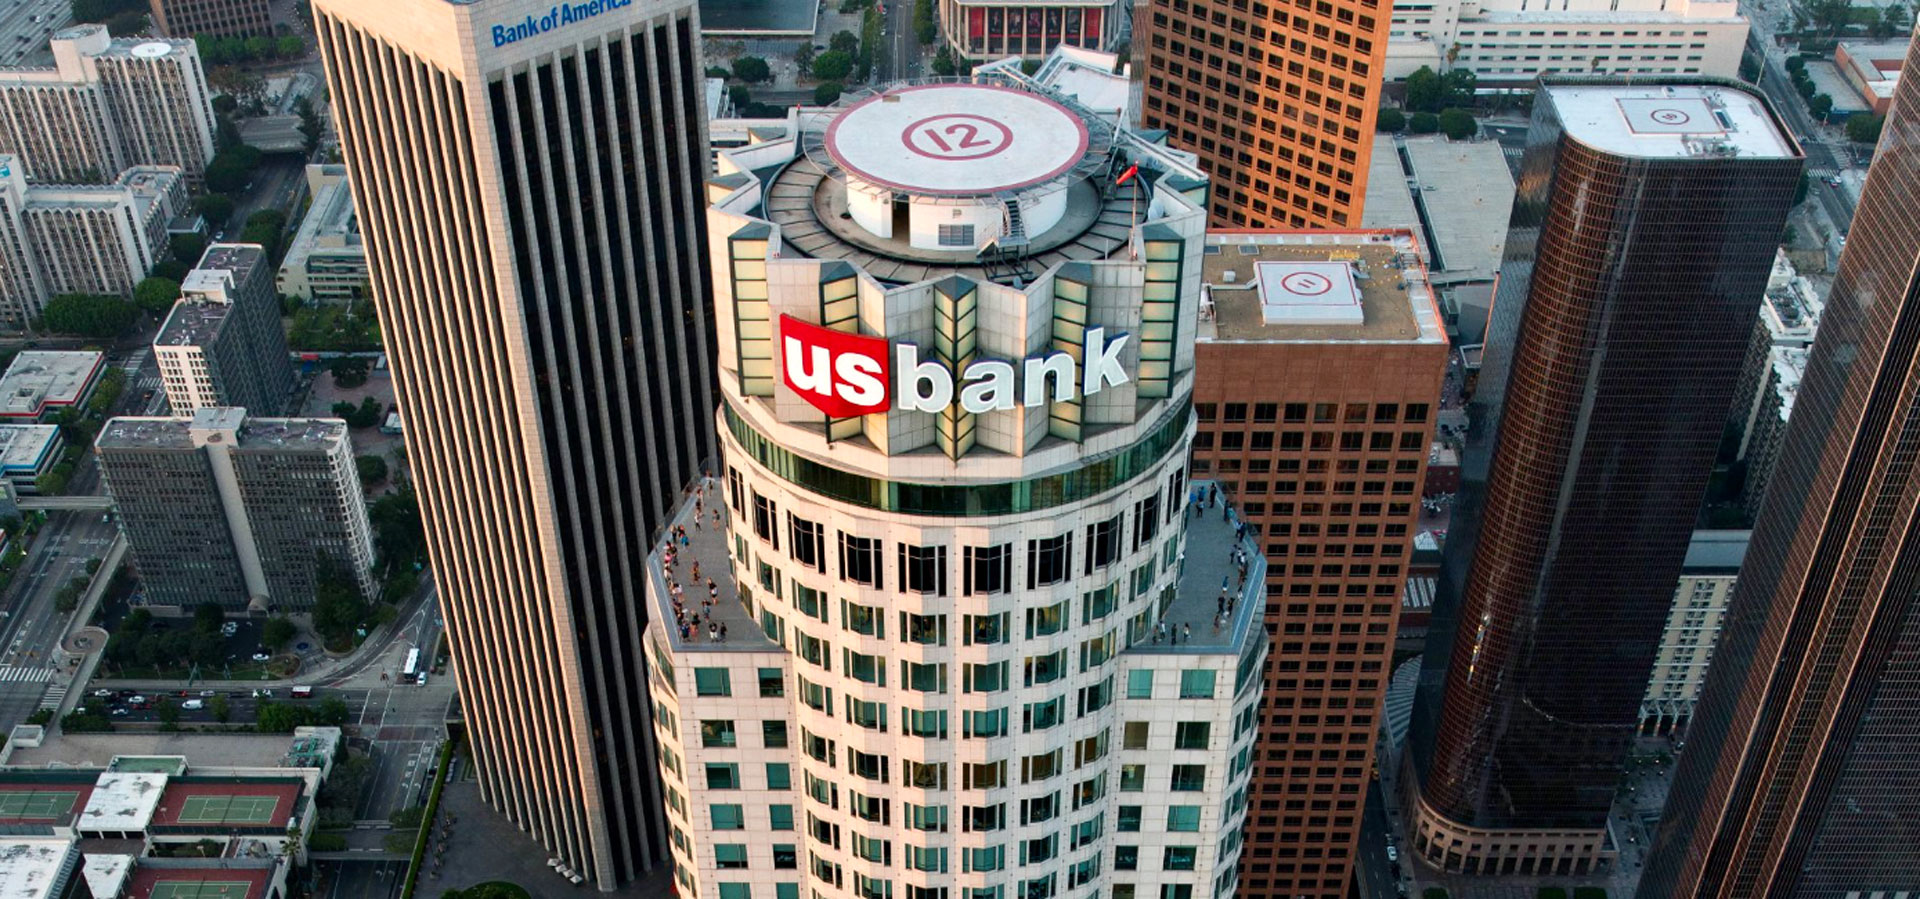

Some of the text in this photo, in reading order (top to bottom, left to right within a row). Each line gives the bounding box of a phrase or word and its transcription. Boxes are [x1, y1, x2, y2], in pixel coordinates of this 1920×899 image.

[492, 16, 539, 47] Bank
[540, 7, 559, 32] of
[924, 124, 991, 152] 12
[896, 324, 1132, 414] bank
